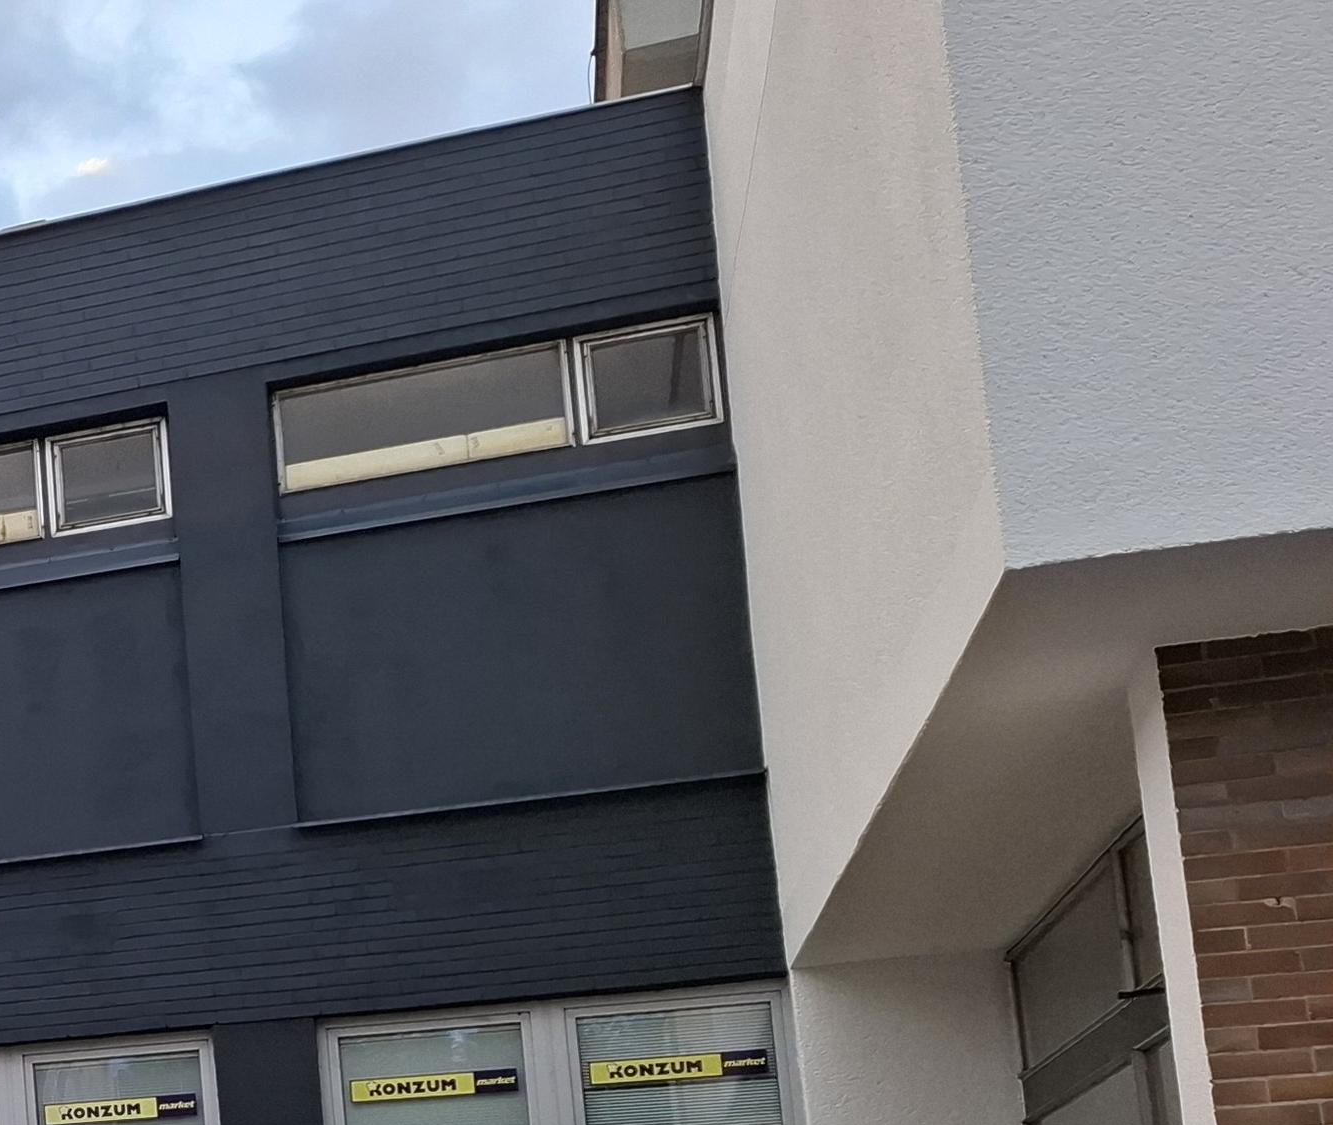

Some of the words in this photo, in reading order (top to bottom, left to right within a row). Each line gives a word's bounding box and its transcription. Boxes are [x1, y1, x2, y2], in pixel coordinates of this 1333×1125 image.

[607, 1060, 703, 1079] KONZUM
[723, 1056, 766, 1069] market
[367, 1079, 457, 1097] KONZUM
[476, 1075, 517, 1088] market
[59, 1101, 142, 1120] KONZUM
[158, 1098, 195, 1112] market
